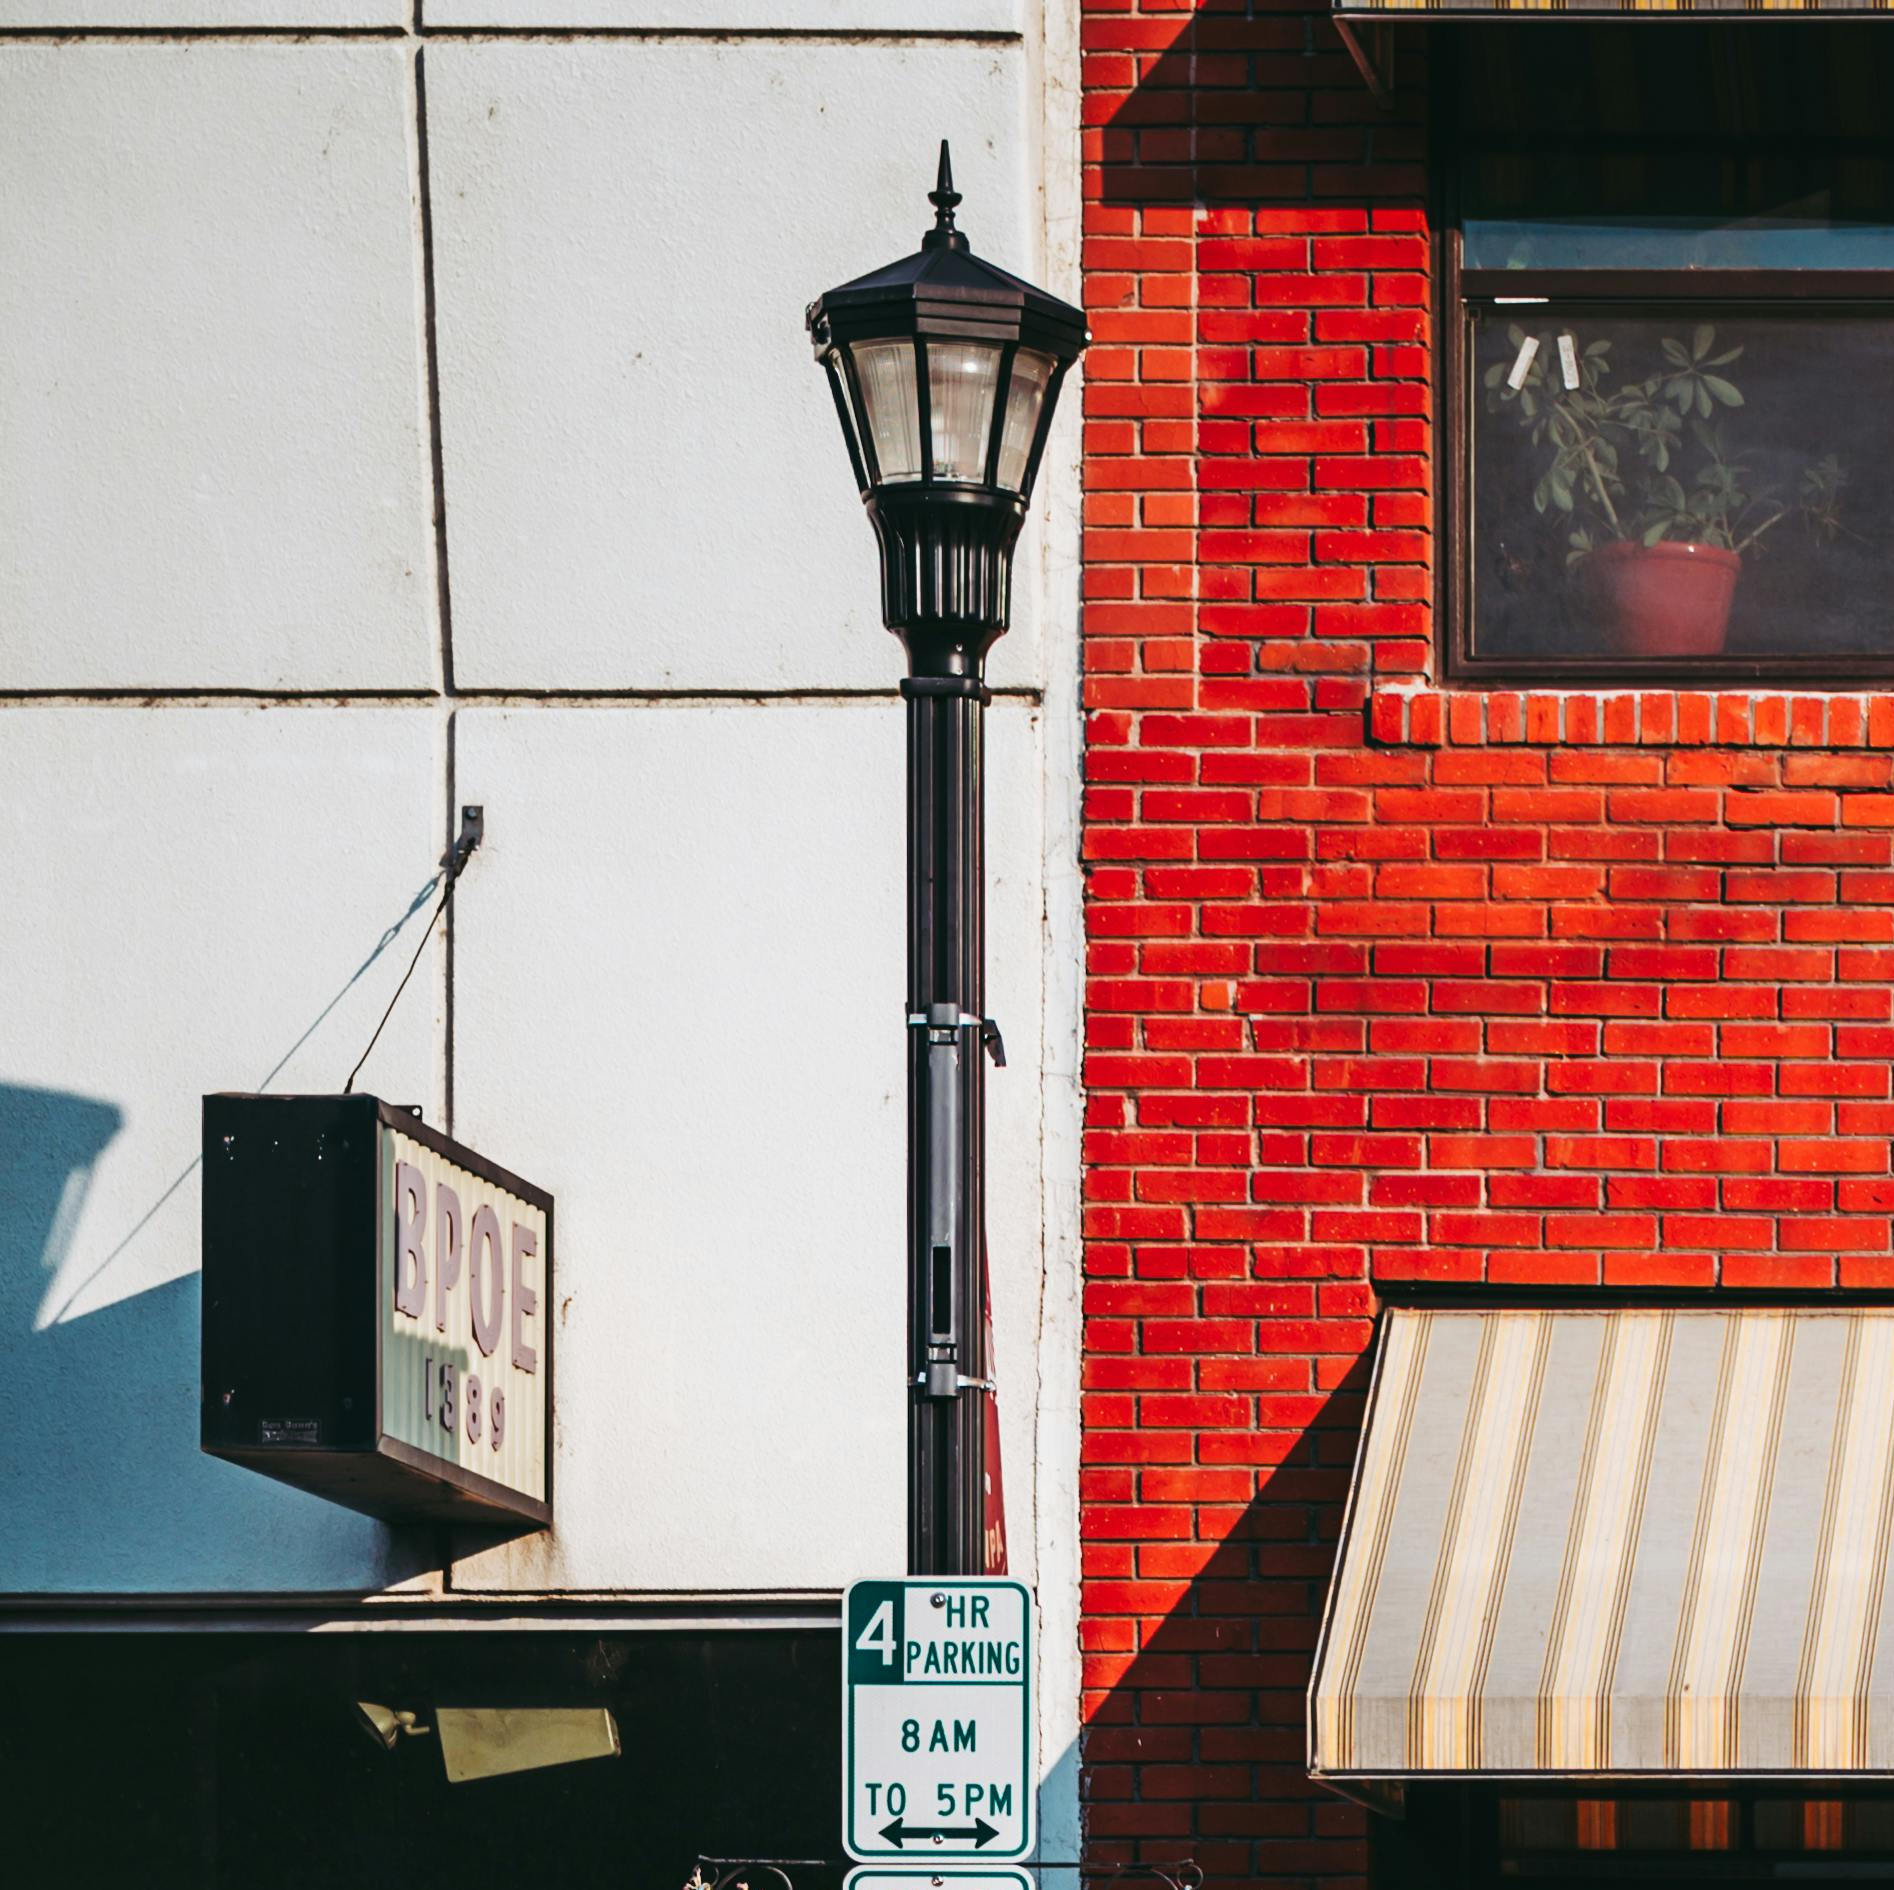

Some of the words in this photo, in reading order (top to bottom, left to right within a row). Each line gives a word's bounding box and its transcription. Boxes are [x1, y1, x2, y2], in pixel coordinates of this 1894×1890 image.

[395, 1160, 537, 1376] BPOE
[425, 1358, 505, 1453] 1389
[855, 1600, 897, 1666] 4
[946, 1595, 990, 1629] HR
[906, 1641, 1020, 1675] PARKING
[865, 1783, 907, 1817] TO
